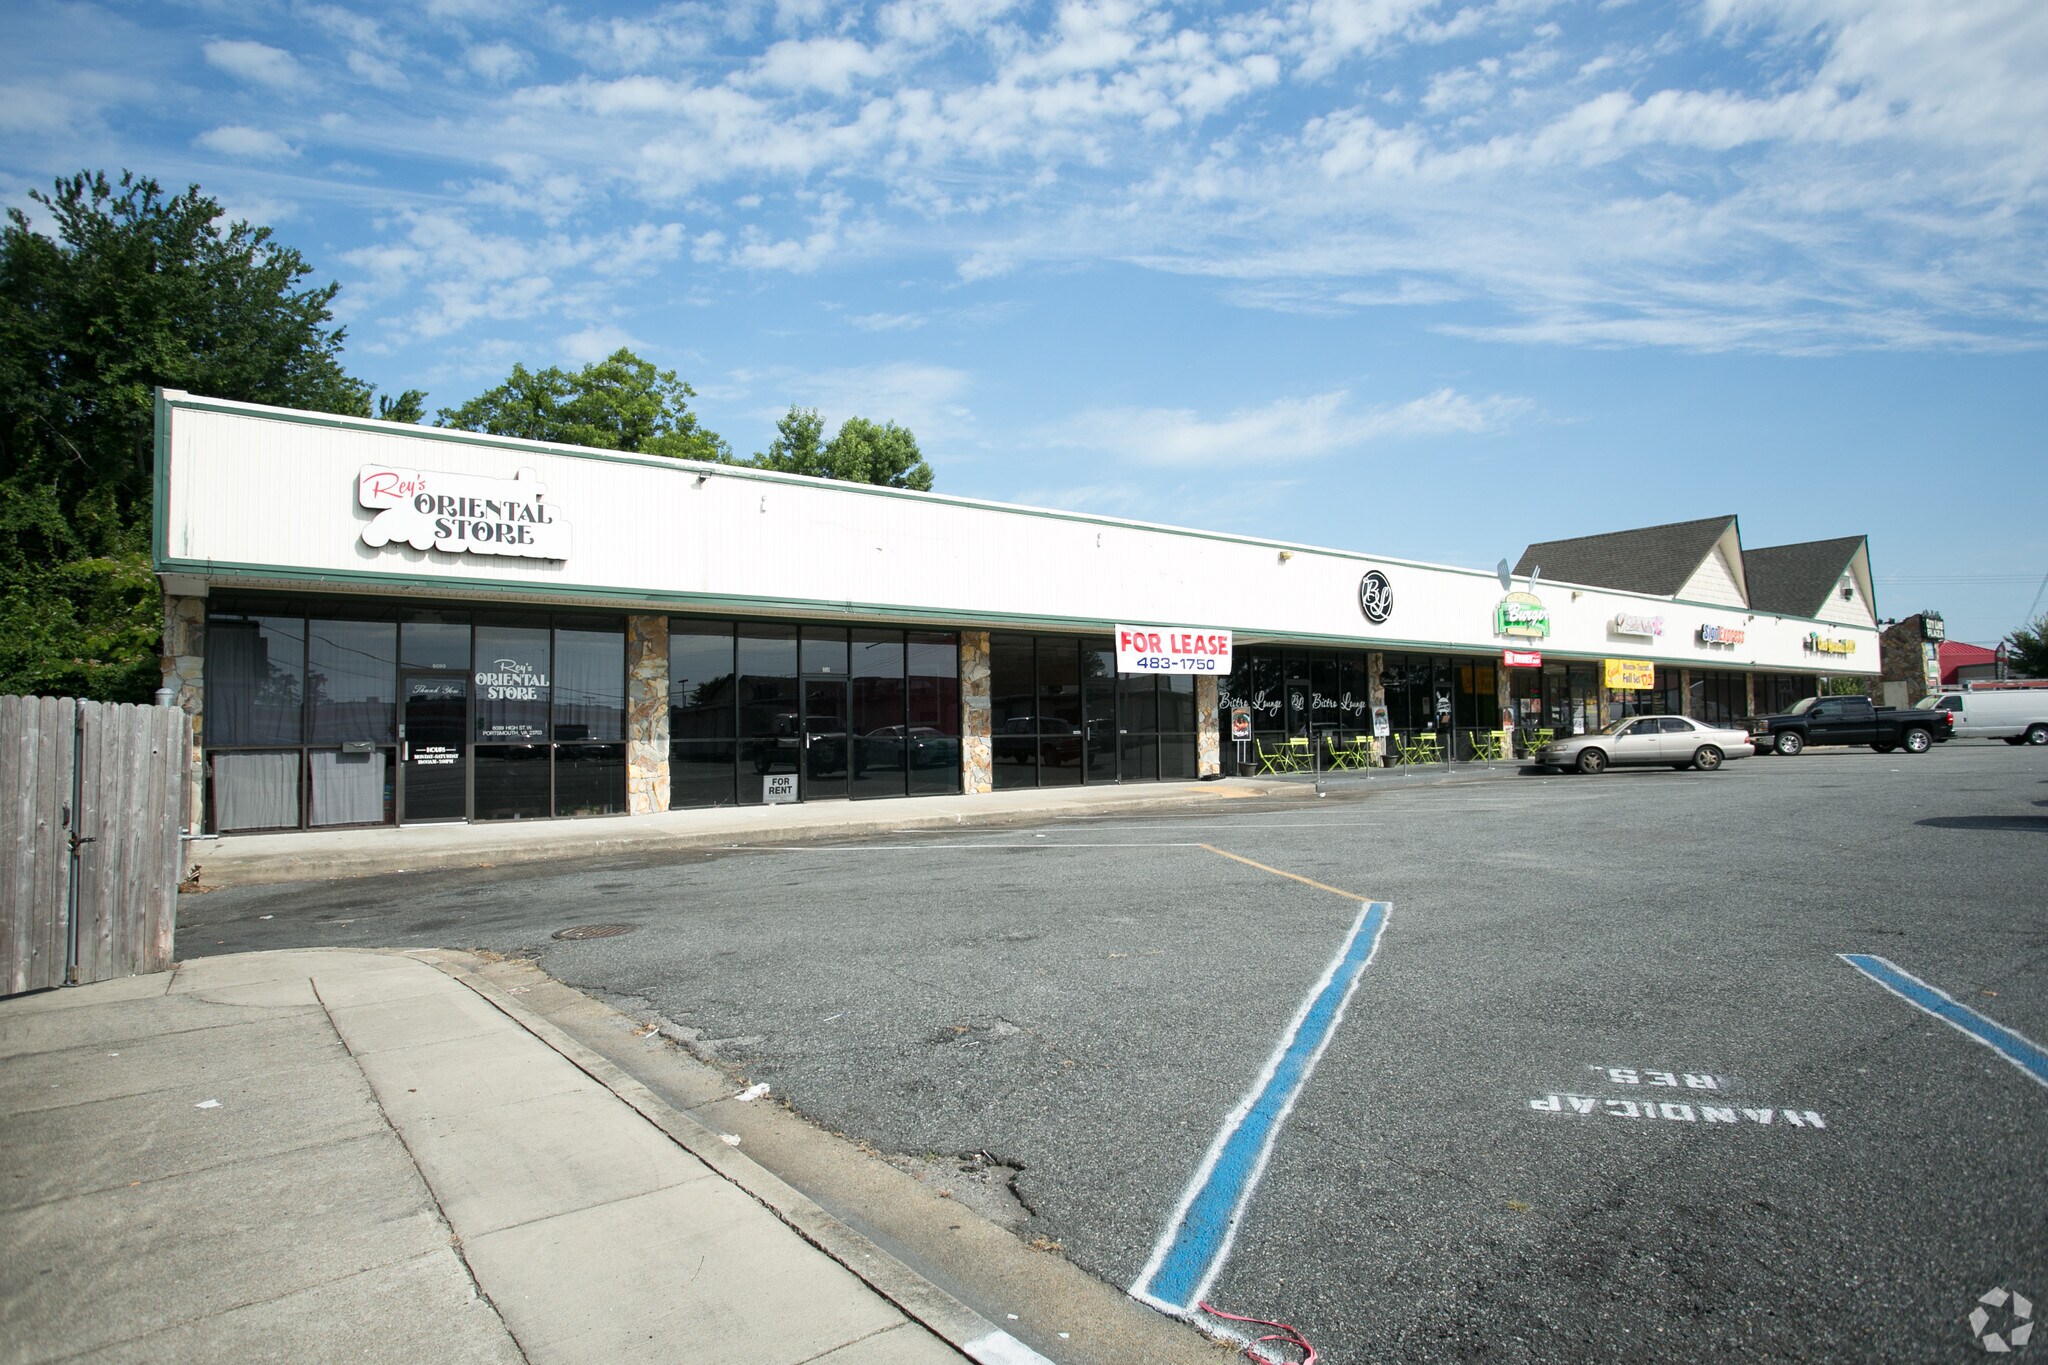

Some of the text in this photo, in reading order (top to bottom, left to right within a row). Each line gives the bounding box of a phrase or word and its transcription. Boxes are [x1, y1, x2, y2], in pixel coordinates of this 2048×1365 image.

[363, 472, 426, 499] Rey's
[414, 492, 553, 525] ORIENTAL
[434, 517, 534, 545] STORE
[1927, 628, 1944, 638] PLAZA
[1121, 631, 1229, 655] FOR LEASE
[493, 658, 533, 674] Rey's
[1136, 657, 1215, 670] 483-1750
[475, 672, 549, 687] ORIENTAL
[412, 684, 459, 694] Thank You
[487, 686, 538, 701] STORE
[1219, 690, 1282, 717] Bistro Lounge
[1312, 691, 1367, 717] Bistro Lounge
[772, 777, 790, 786] FOR
[768, 786, 792, 795] RENT
[1530, 1094, 1827, 1129] HANDICAP
